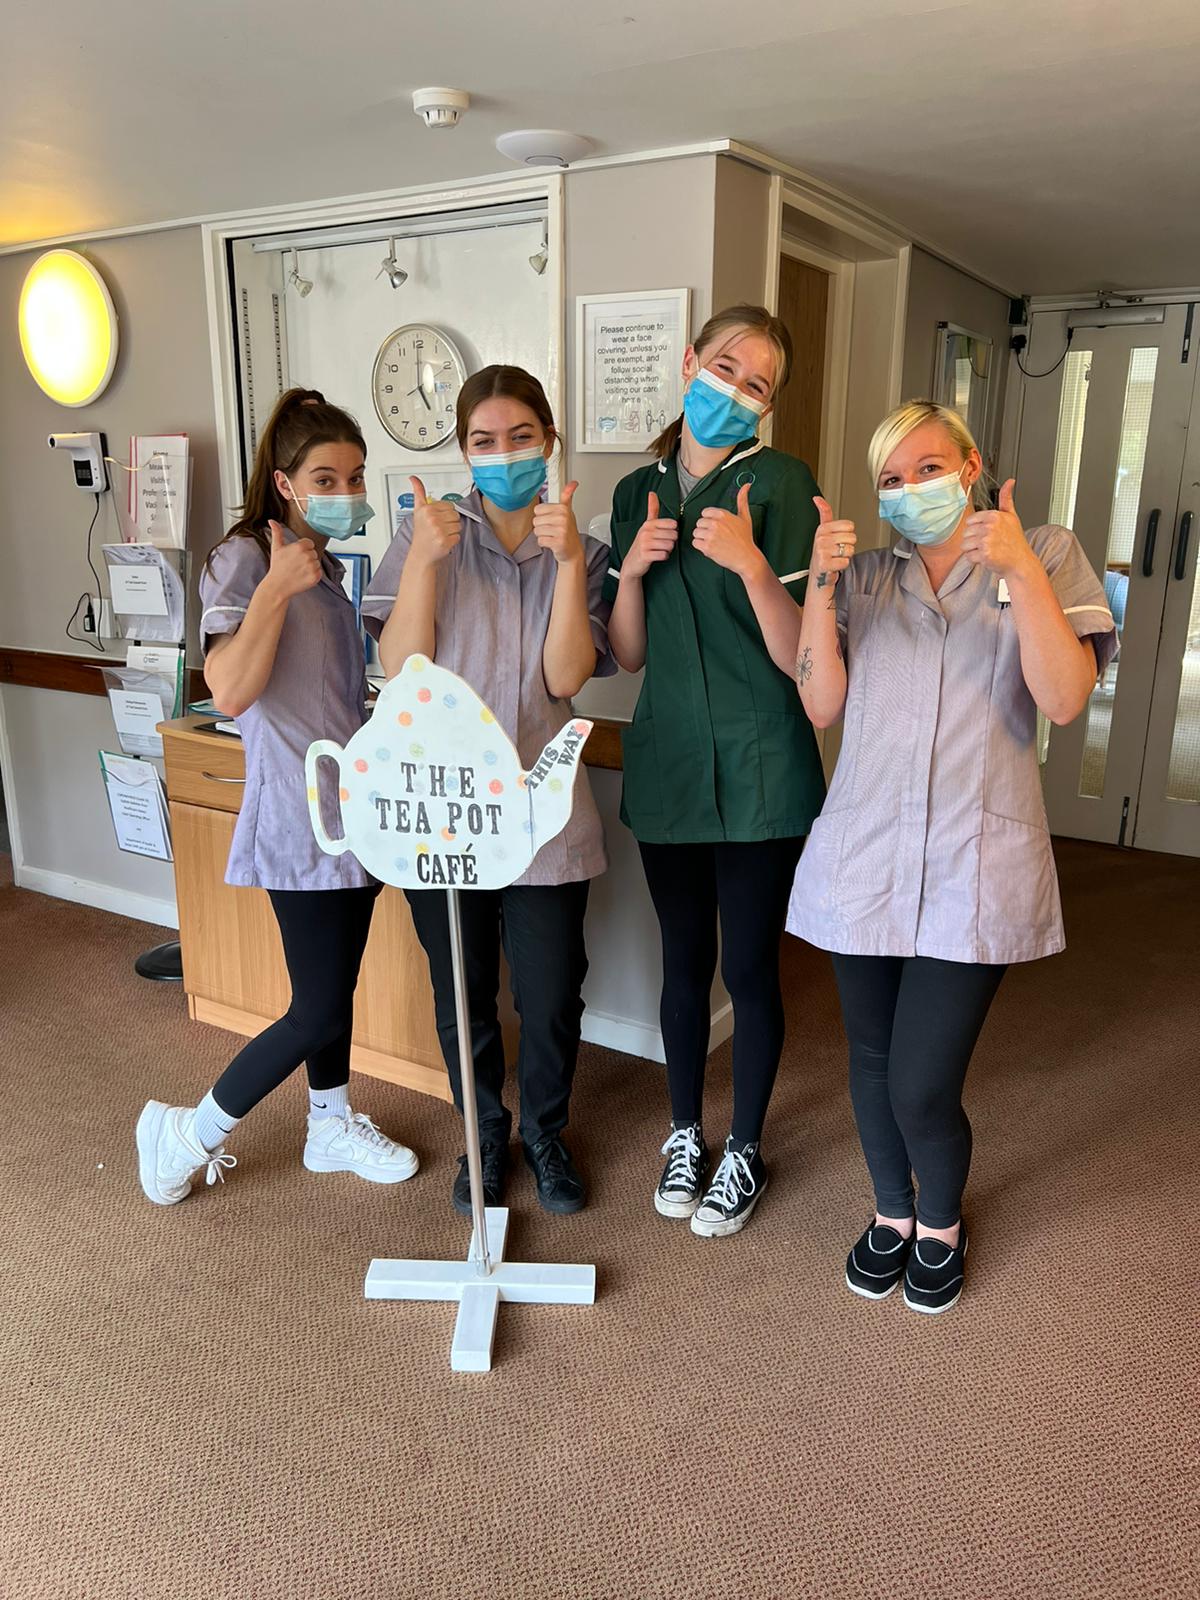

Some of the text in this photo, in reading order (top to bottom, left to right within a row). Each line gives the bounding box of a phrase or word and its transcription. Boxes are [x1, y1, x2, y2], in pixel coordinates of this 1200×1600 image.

[600, 322, 665, 334] Please continue to
[637, 333, 652, 342] face
[412, 339, 424, 349] 12
[399, 347, 406, 357] 11
[597, 344, 667, 355] covering, unless you
[616, 355, 645, 364] exempt,
[646, 354, 660, 362] and
[387, 363, 399, 373] 10
[443, 360, 452, 370] 2
[610, 364, 653, 374] follow social
[604, 375, 660, 385] distancing when
[384, 384, 393, 393] 9
[604, 386, 629, 395] visiting
[390, 405, 400, 414] 8
[445, 404, 454, 412] 4
[401, 420, 410, 430] 7
[435, 420, 444, 430] 5
[418, 427, 428, 436] 6
[556, 725, 584, 767] WAY
[523, 746, 559, 790] THIS
[400, 761, 475, 799] THE
[375, 797, 503, 836] TEA POT
[416, 842, 479, 886] CAFÉ
